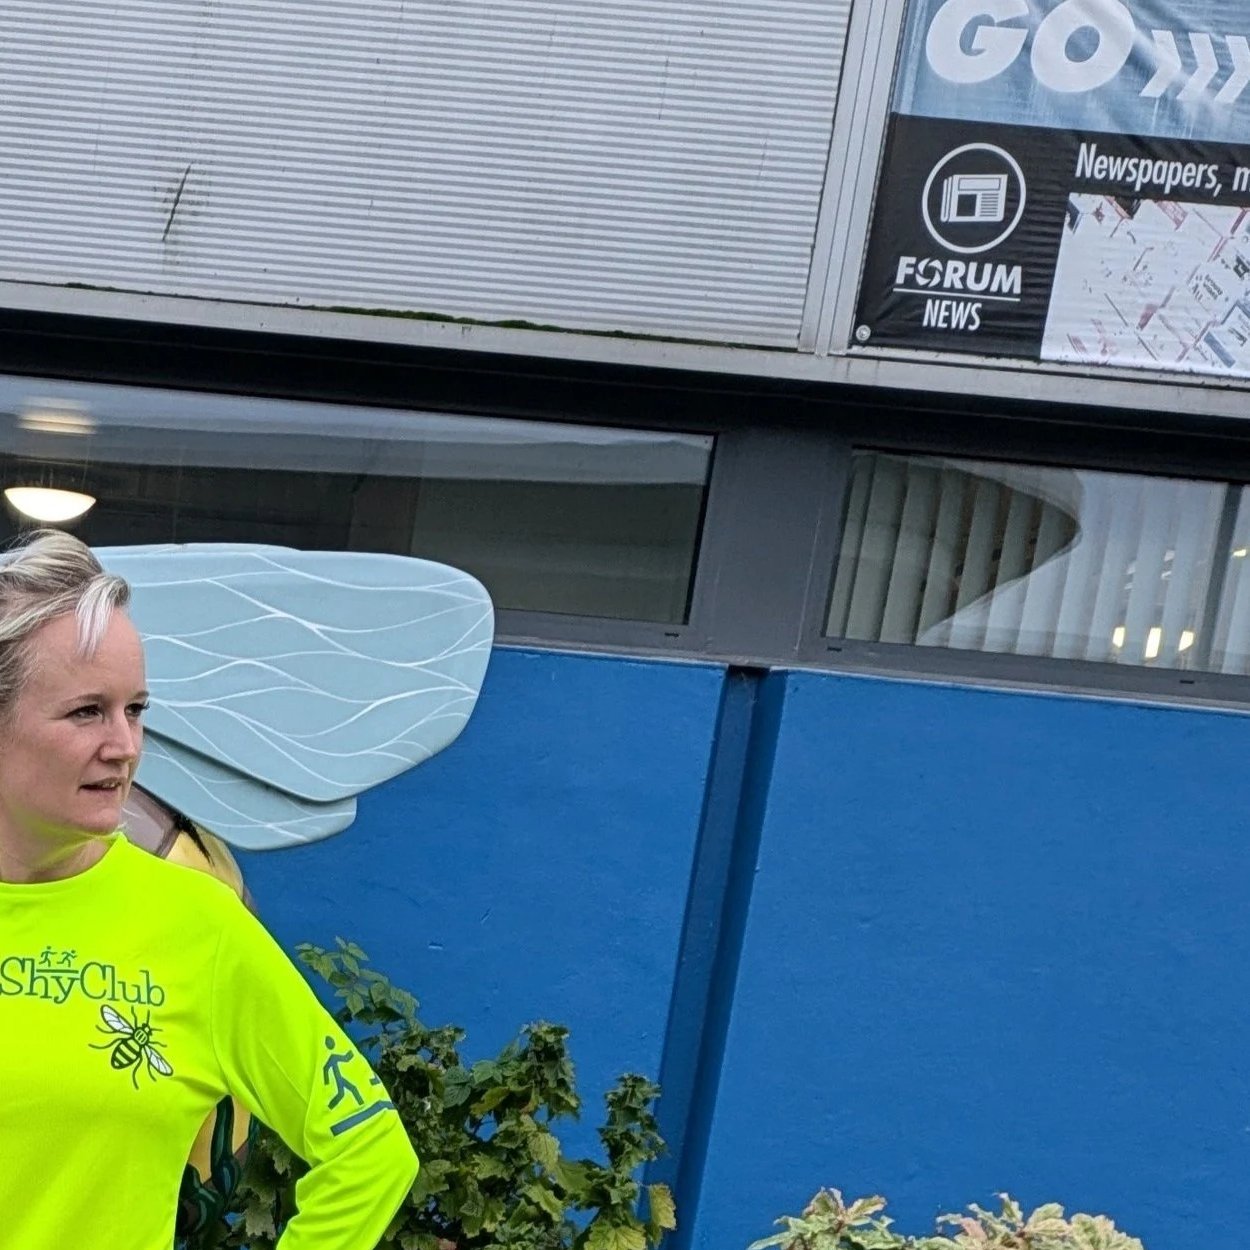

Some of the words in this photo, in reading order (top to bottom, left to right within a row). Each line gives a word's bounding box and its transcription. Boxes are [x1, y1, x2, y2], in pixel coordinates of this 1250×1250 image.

[926, 0, 1136, 93] GO
[1075, 142, 1223, 197] Newspapers,
[895, 256, 1022, 294] FORUM
[922, 299, 982, 331] NEWS
